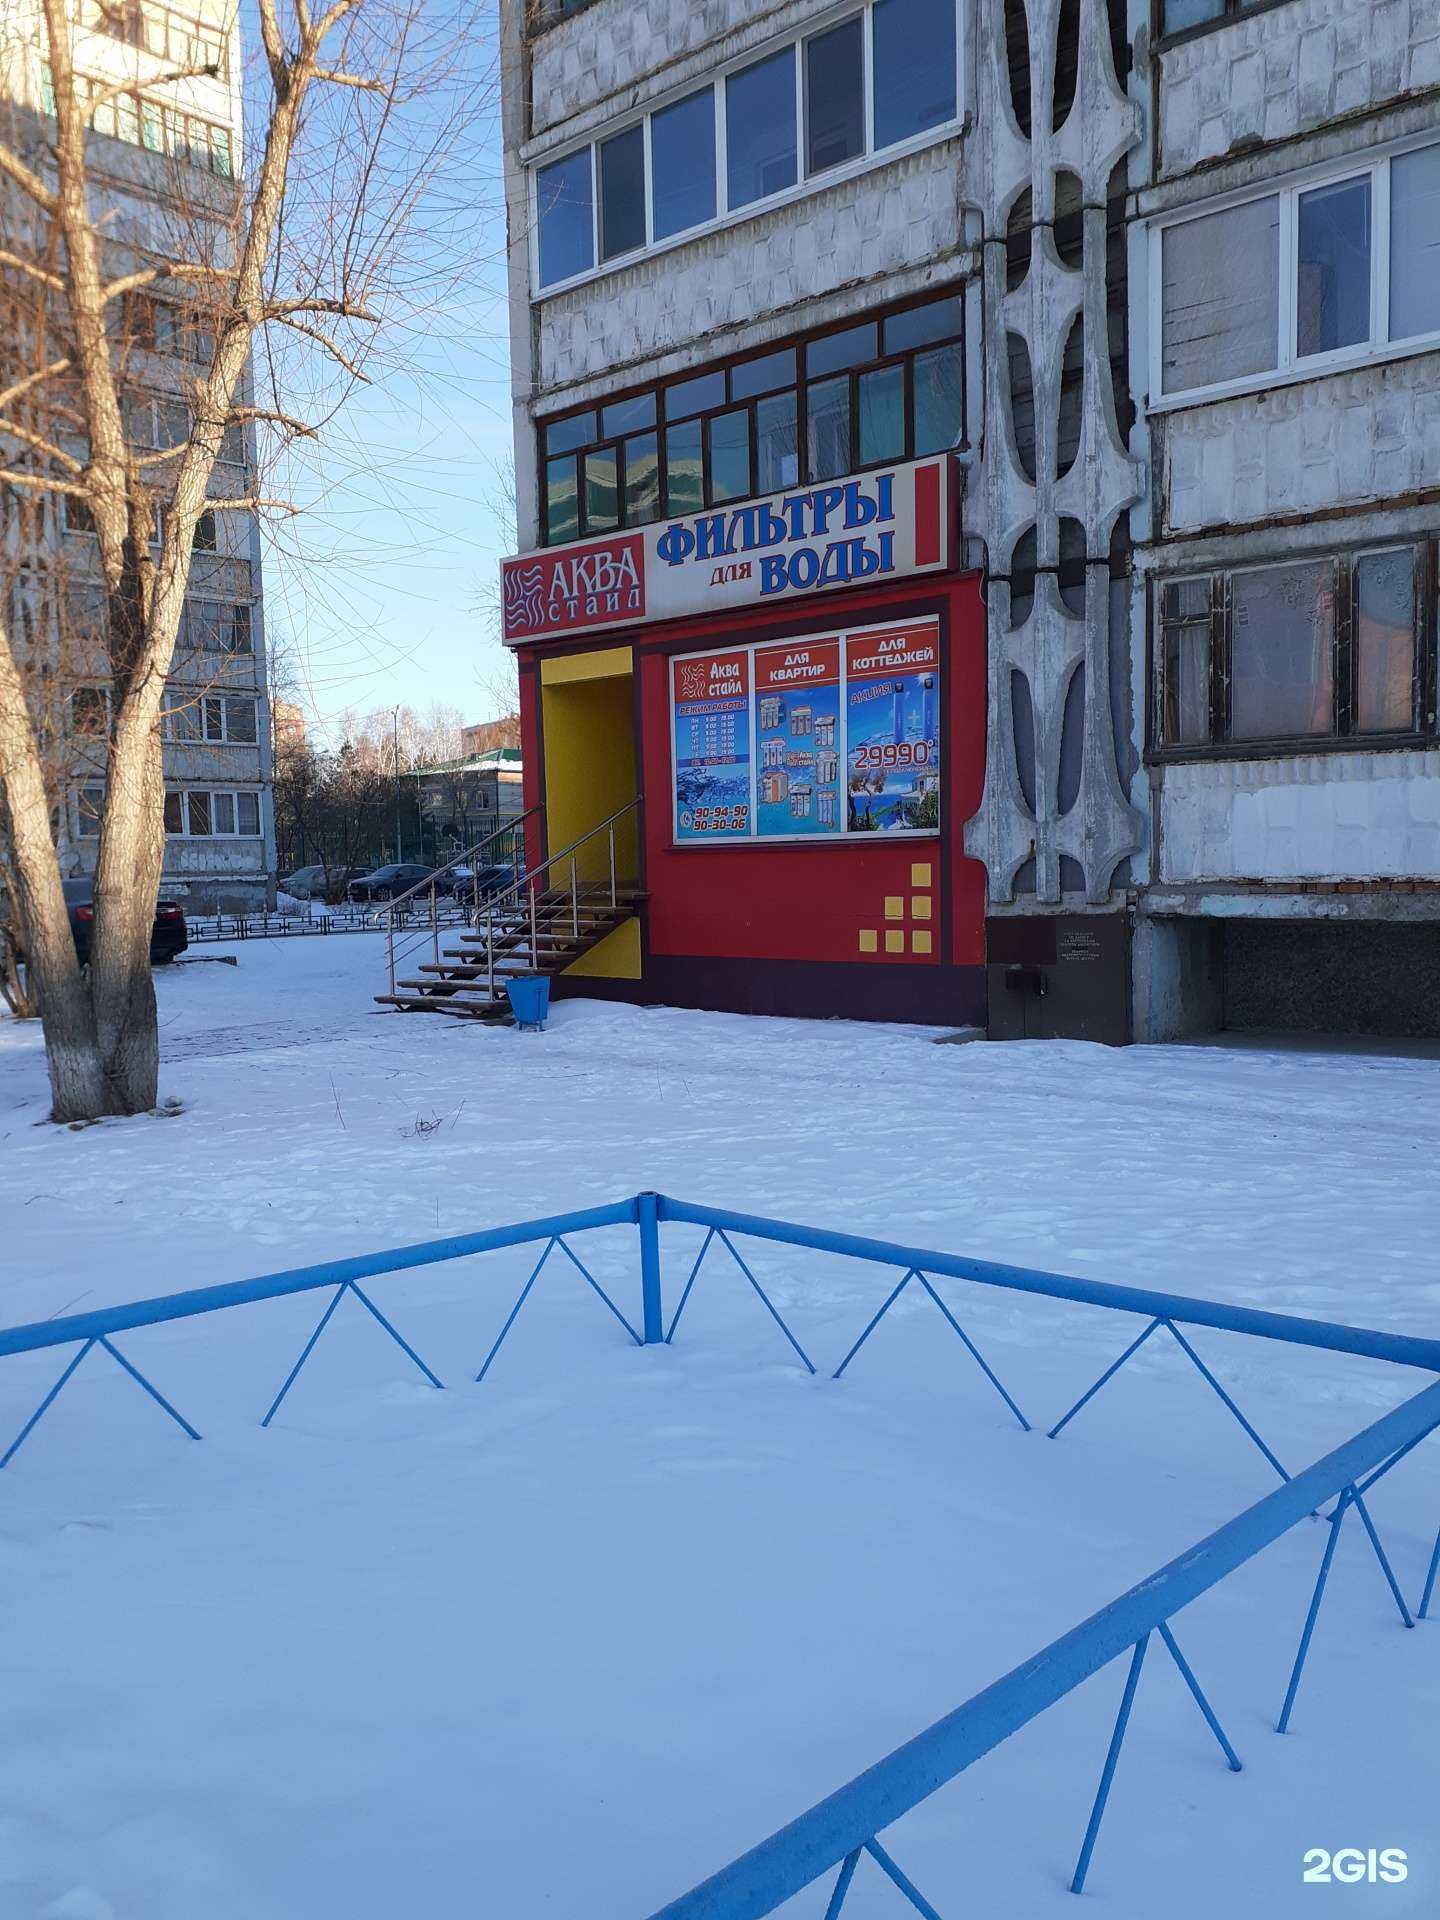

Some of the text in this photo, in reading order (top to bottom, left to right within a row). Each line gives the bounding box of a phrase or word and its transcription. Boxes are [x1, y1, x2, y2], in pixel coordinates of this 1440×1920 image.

[656, 472, 896, 567] ФИЛЬТРЫ
[709, 530, 896, 596] для ВОДЫ
[548, 546, 640, 601] АКВА
[878, 637, 906, 652] ДЛЯ
[784, 653, 809, 666] ДЛЯ
[852, 646, 934, 670] КОТТЕДЖЕЙ
[769, 665, 825, 681] КВАРТИР
[709, 679, 743, 696] стайл
[695, 805, 748, 818] 90-94-90
[694, 818, 746, 831] 90-30-06
